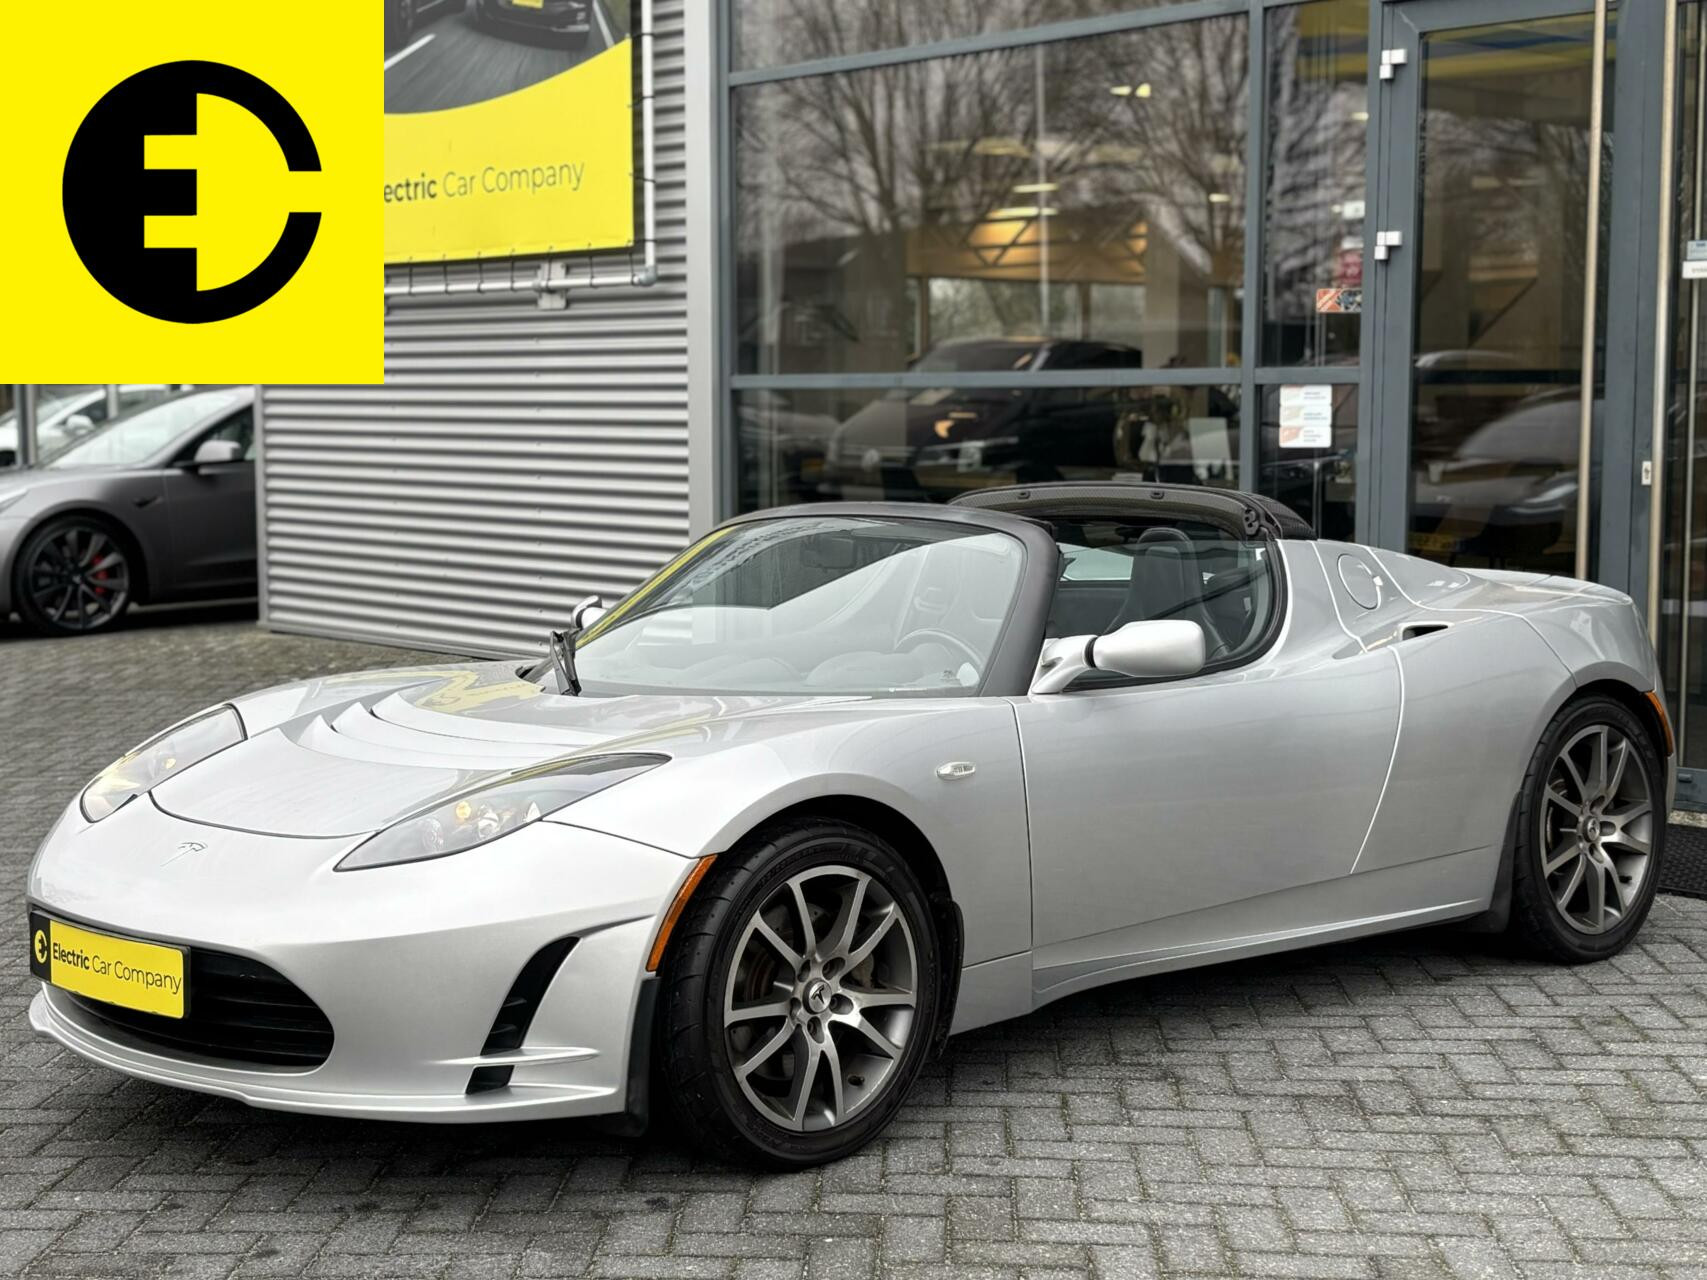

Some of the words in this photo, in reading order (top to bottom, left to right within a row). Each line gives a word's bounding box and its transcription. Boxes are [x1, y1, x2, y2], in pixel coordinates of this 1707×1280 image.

[384, 172, 437, 203] ectric
[443, 171, 475, 198] Car
[482, 162, 585, 195] Company
[52, 942, 90, 970] Electric
[92, 955, 112, 976] Car
[114, 960, 182, 995] Company
